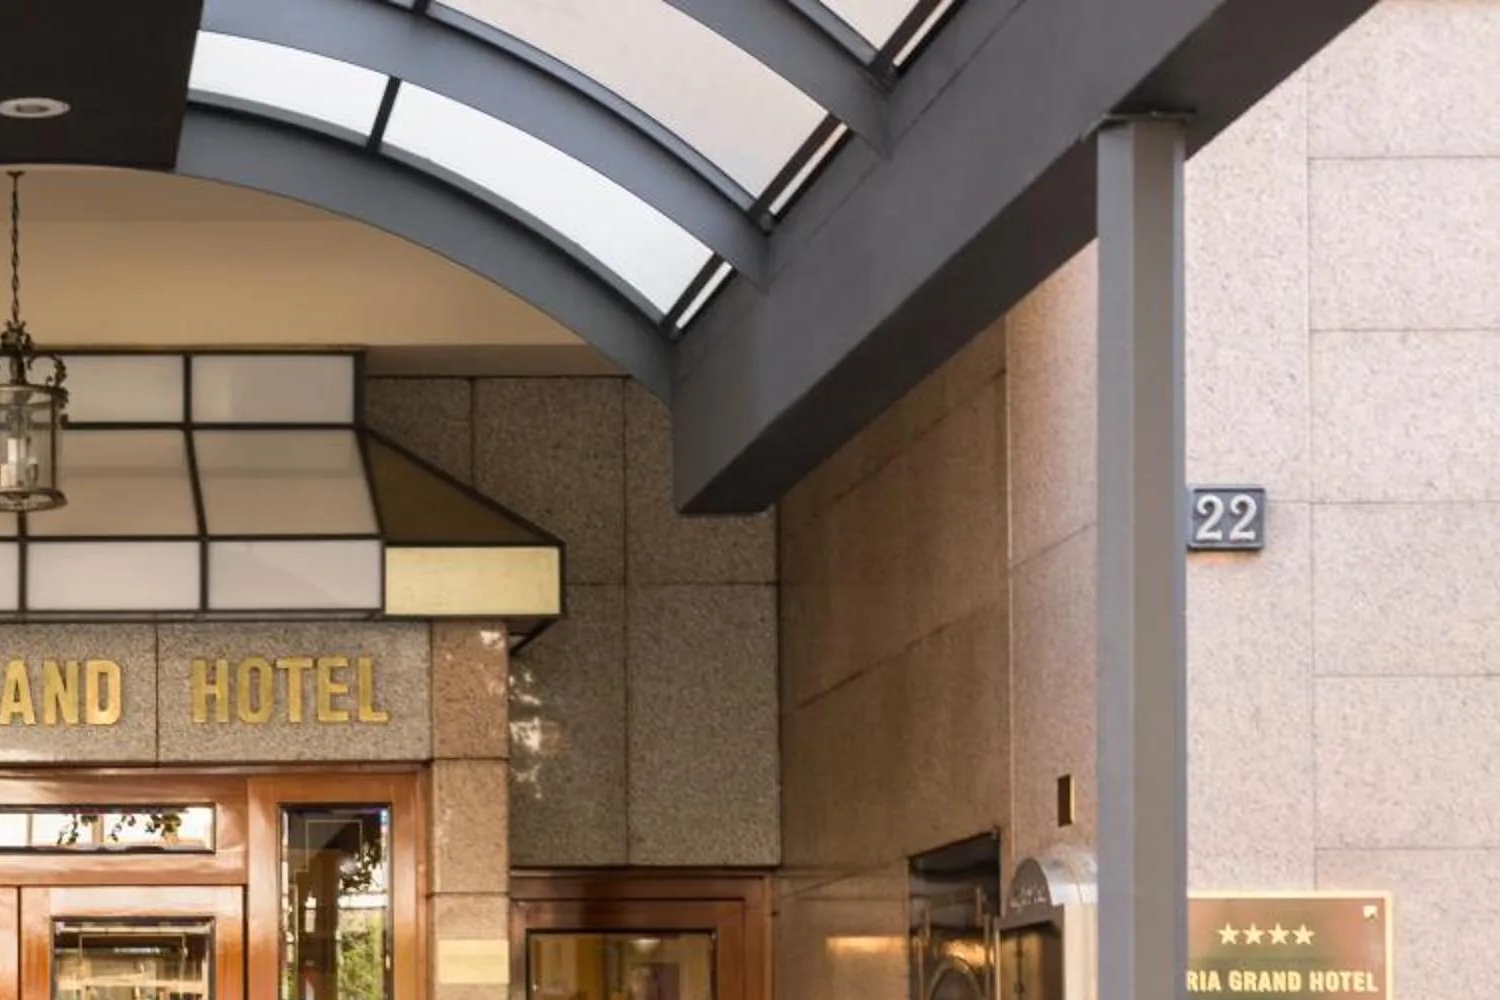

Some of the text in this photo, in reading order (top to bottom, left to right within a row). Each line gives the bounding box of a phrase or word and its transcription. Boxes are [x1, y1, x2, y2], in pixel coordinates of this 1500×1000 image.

[1196, 494, 1257, 540] 22
[190, 655, 389, 725] HOTEL
[1187, 970, 1379, 993] RIA GRAND HOTEL
